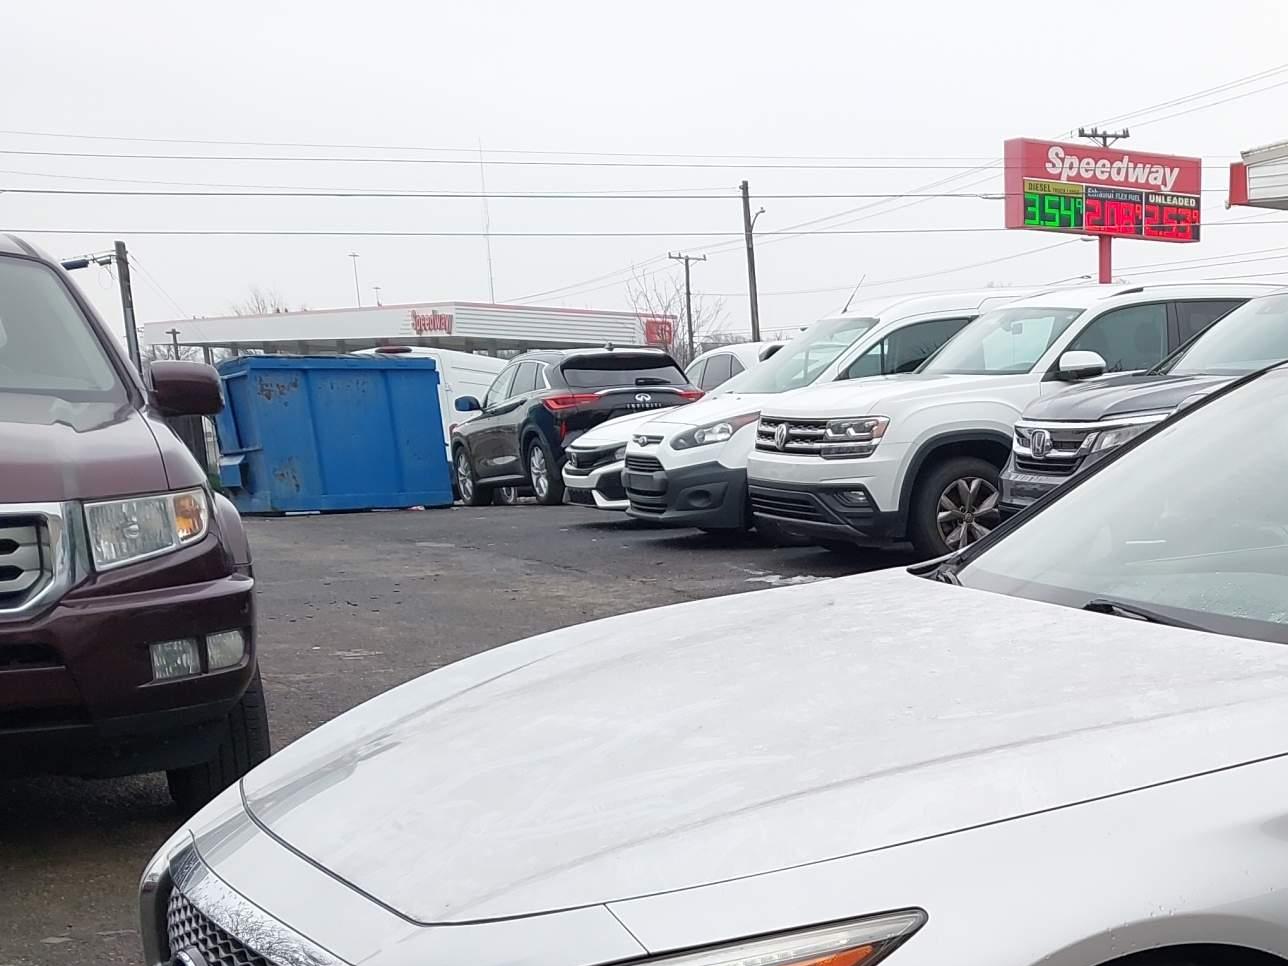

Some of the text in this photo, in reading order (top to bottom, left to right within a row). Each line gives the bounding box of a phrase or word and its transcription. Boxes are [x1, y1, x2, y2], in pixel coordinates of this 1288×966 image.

[1045, 146, 1180, 192] Speedway
[1028, 182, 1051, 193] DIESEL
[1148, 193, 1196, 207] UNLEADED
